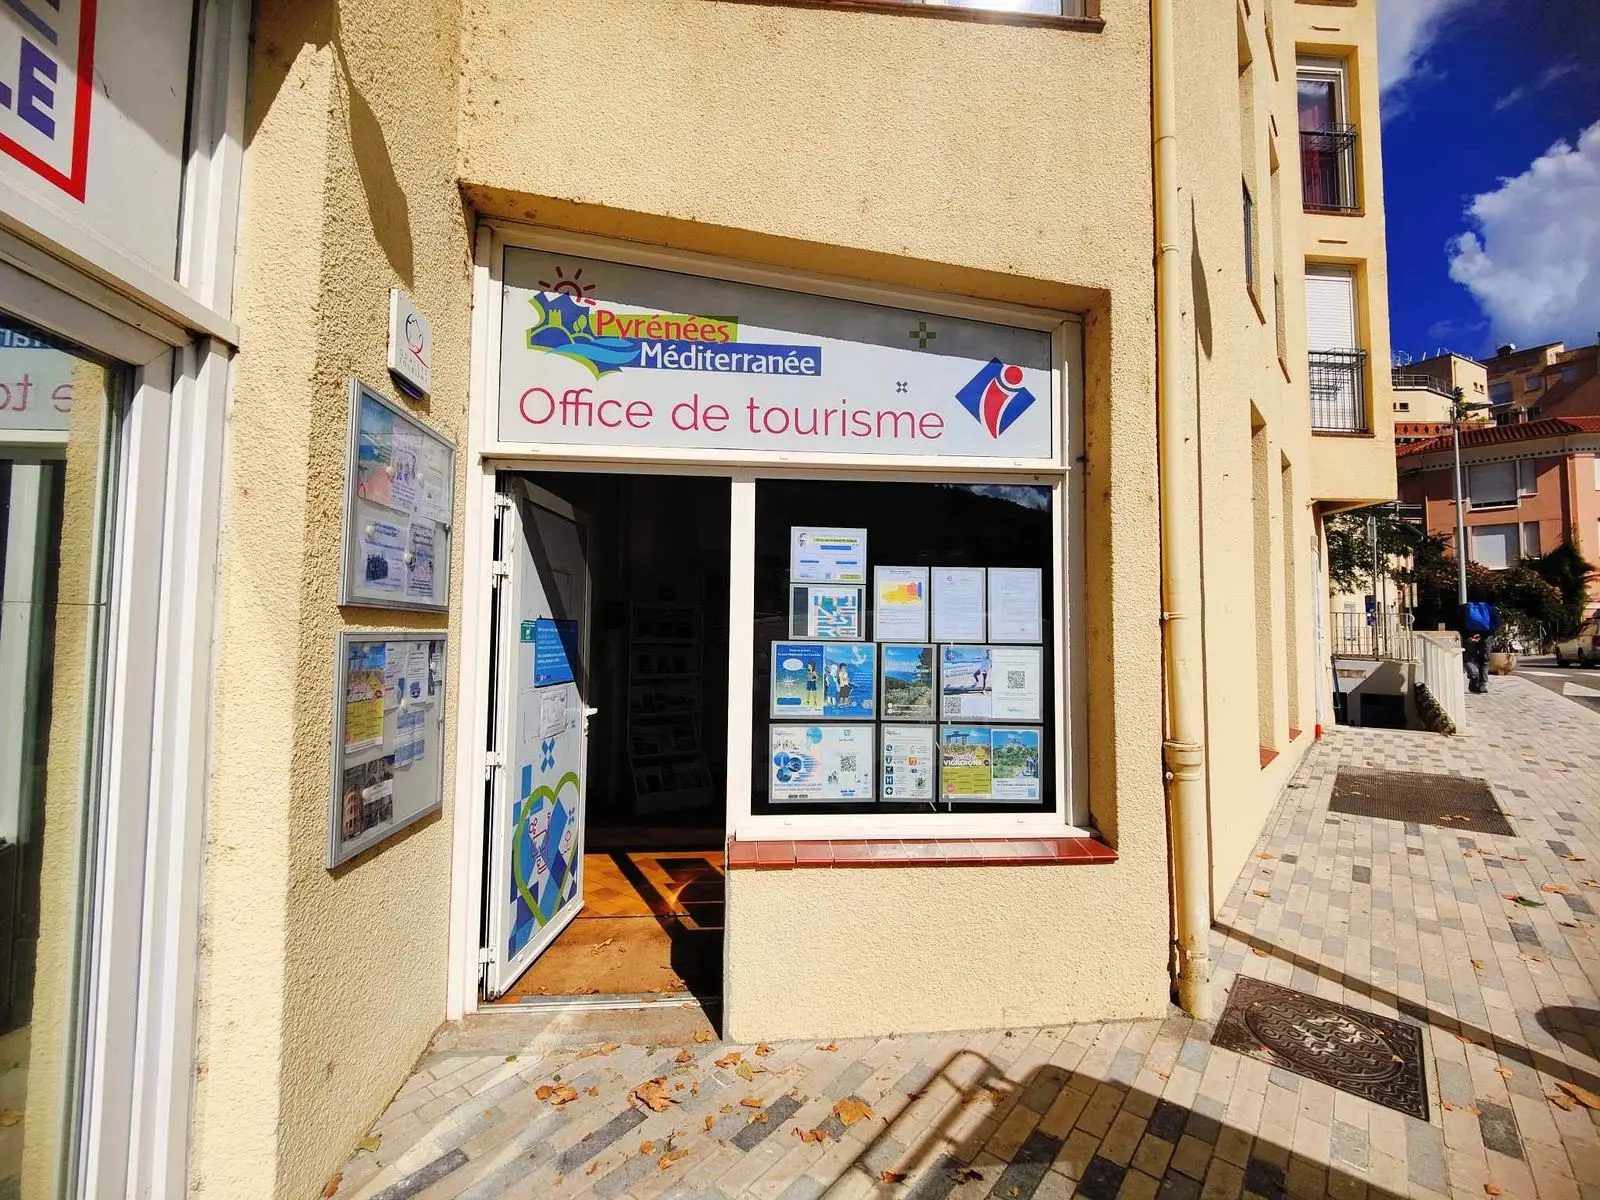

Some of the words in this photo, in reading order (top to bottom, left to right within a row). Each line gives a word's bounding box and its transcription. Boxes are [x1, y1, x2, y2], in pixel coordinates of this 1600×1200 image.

[595, 309, 731, 343] Pyrénées
[640, 341, 816, 375] Méditerranée
[519, 387, 654, 429] Office
[671, 393, 730, 432] de
[746, 397, 945, 440] tourisme
